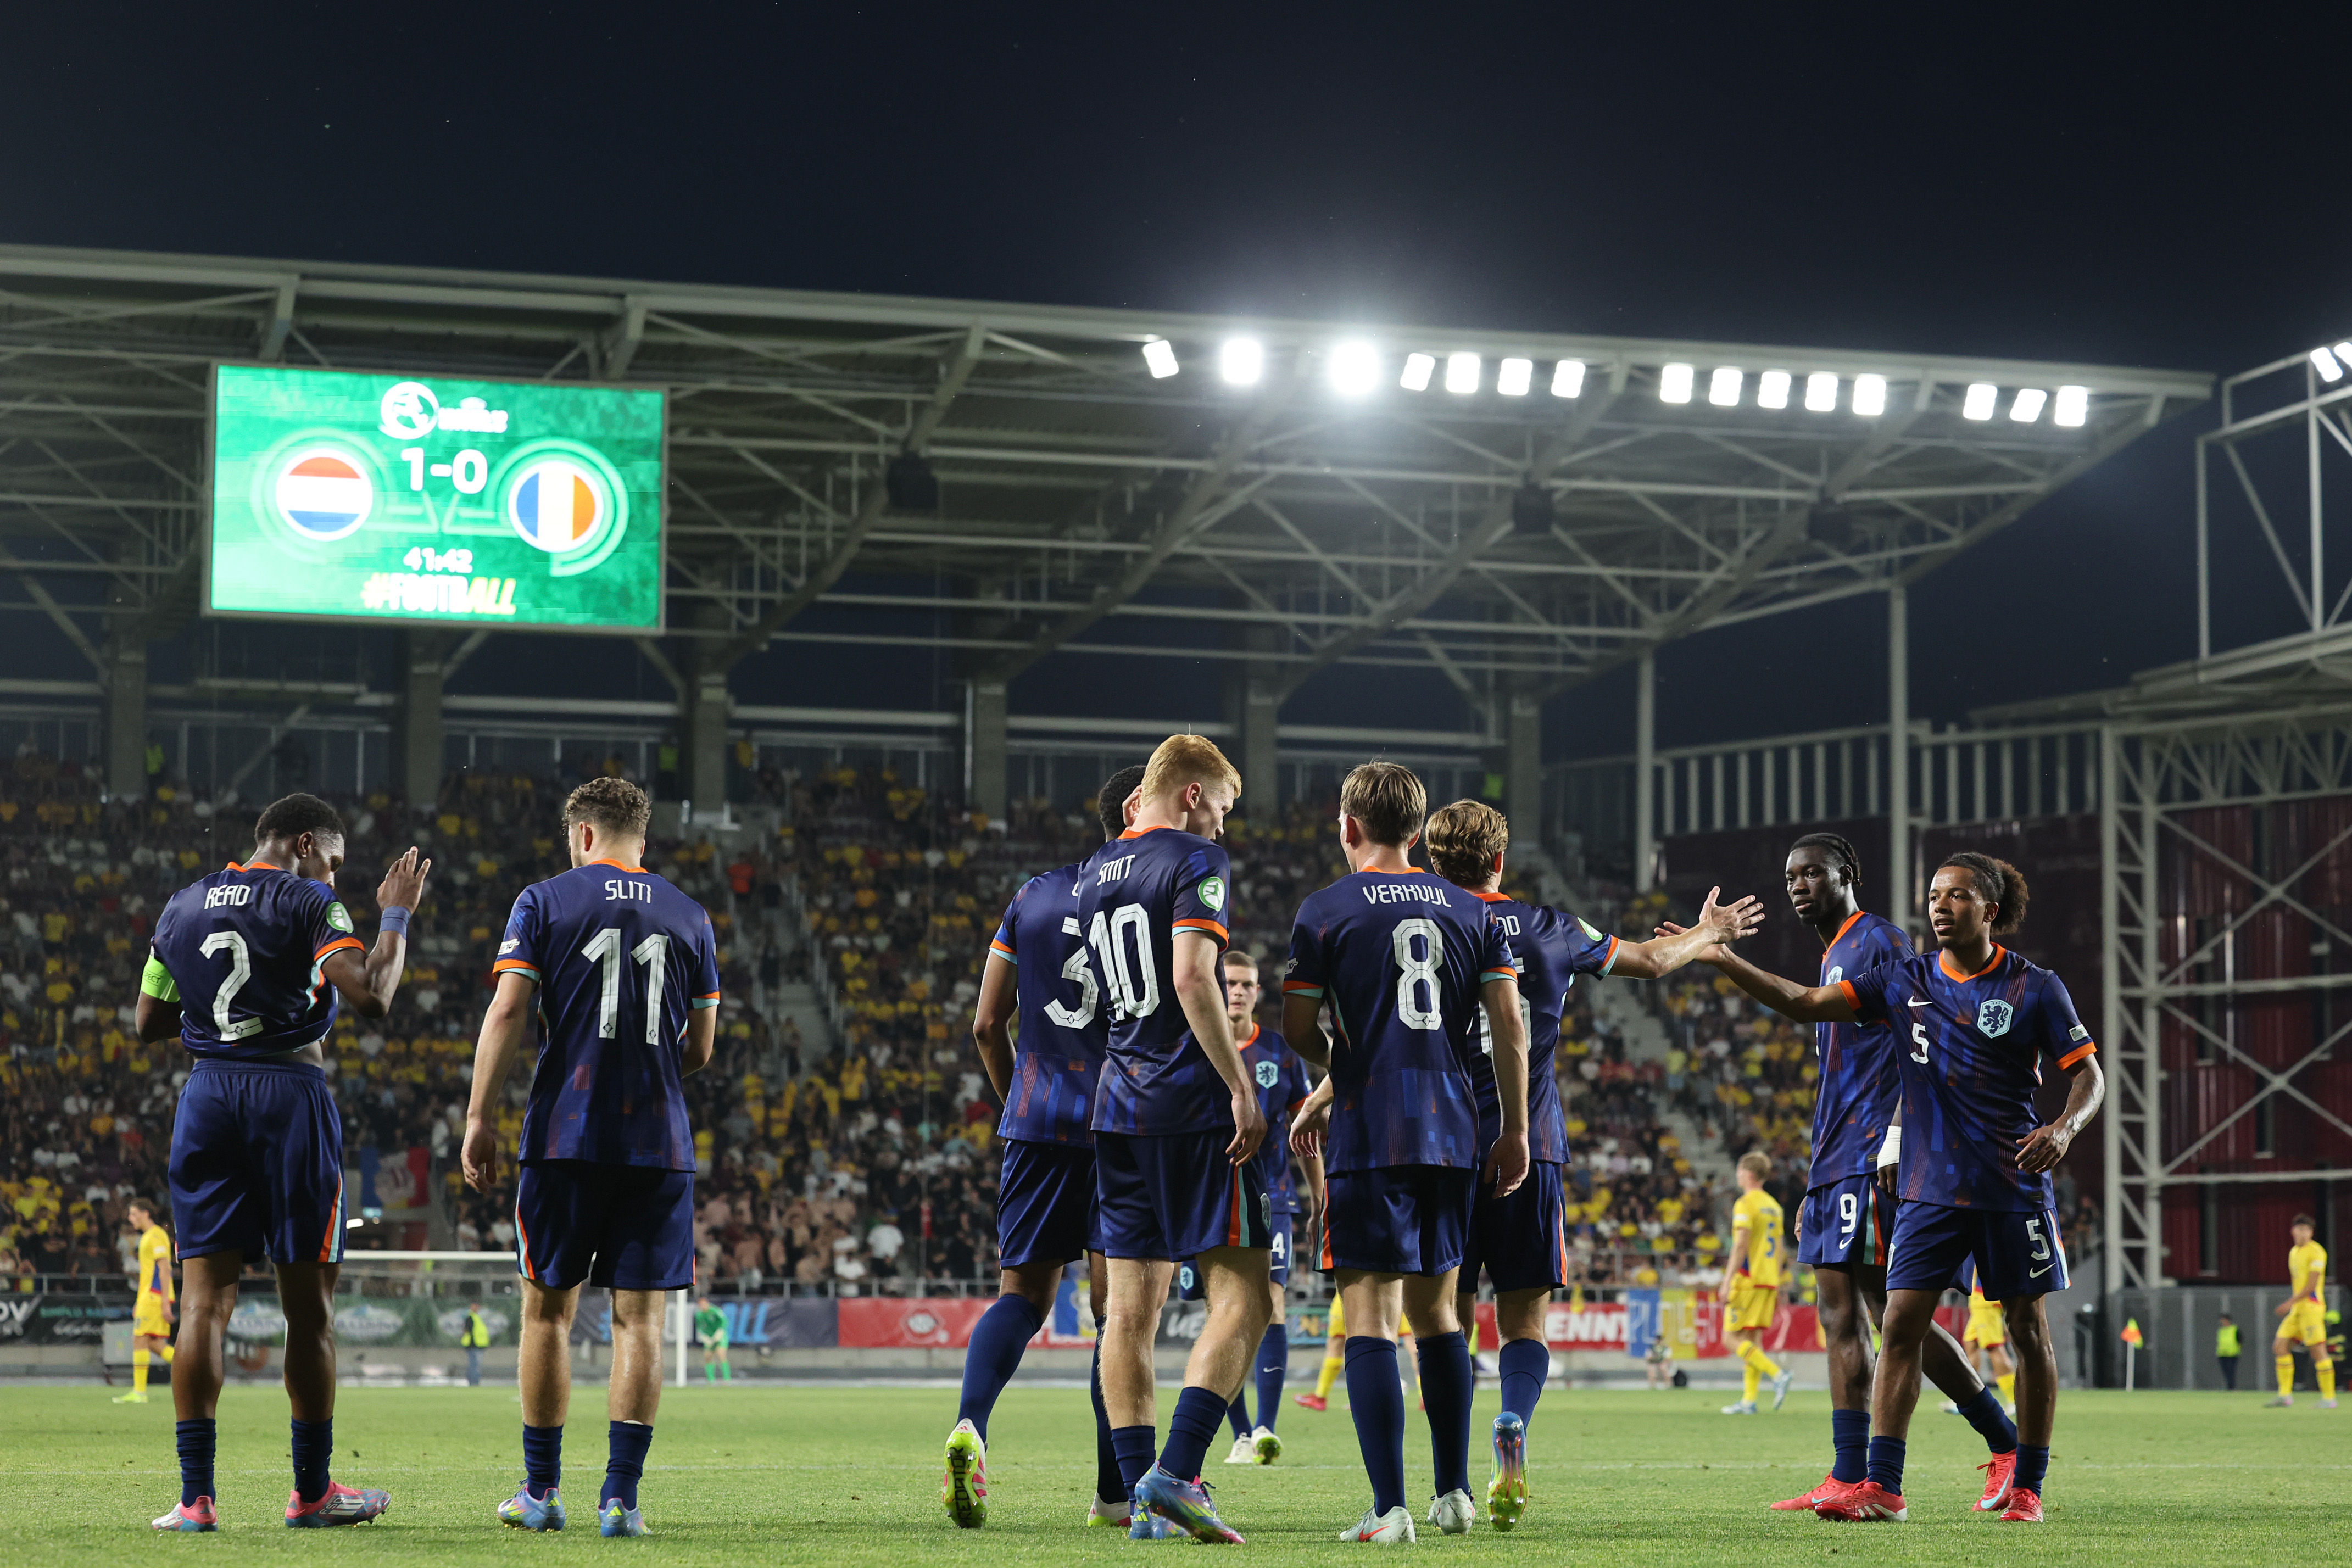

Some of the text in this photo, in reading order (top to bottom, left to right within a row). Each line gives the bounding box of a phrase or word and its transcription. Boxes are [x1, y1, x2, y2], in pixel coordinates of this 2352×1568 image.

[401, 447, 487, 494] 1-0
[403, 546, 473, 573] 41:42
[1097, 854, 1135, 886] SMIT
[204, 884, 251, 909] READ
[605, 880, 651, 903] SLITI
[1044, 916, 1099, 1030] 3
[1088, 903, 1160, 1021] 10
[1392, 919, 1443, 1030] 8
[199, 931, 264, 1041] 2
[581, 928, 668, 1046] 11
[1910, 1023, 1930, 1064] 5
[1840, 1193, 1857, 1234] 9
[1271, 1232, 1285, 1259] 4
[2026, 1219, 2051, 1261] 5
